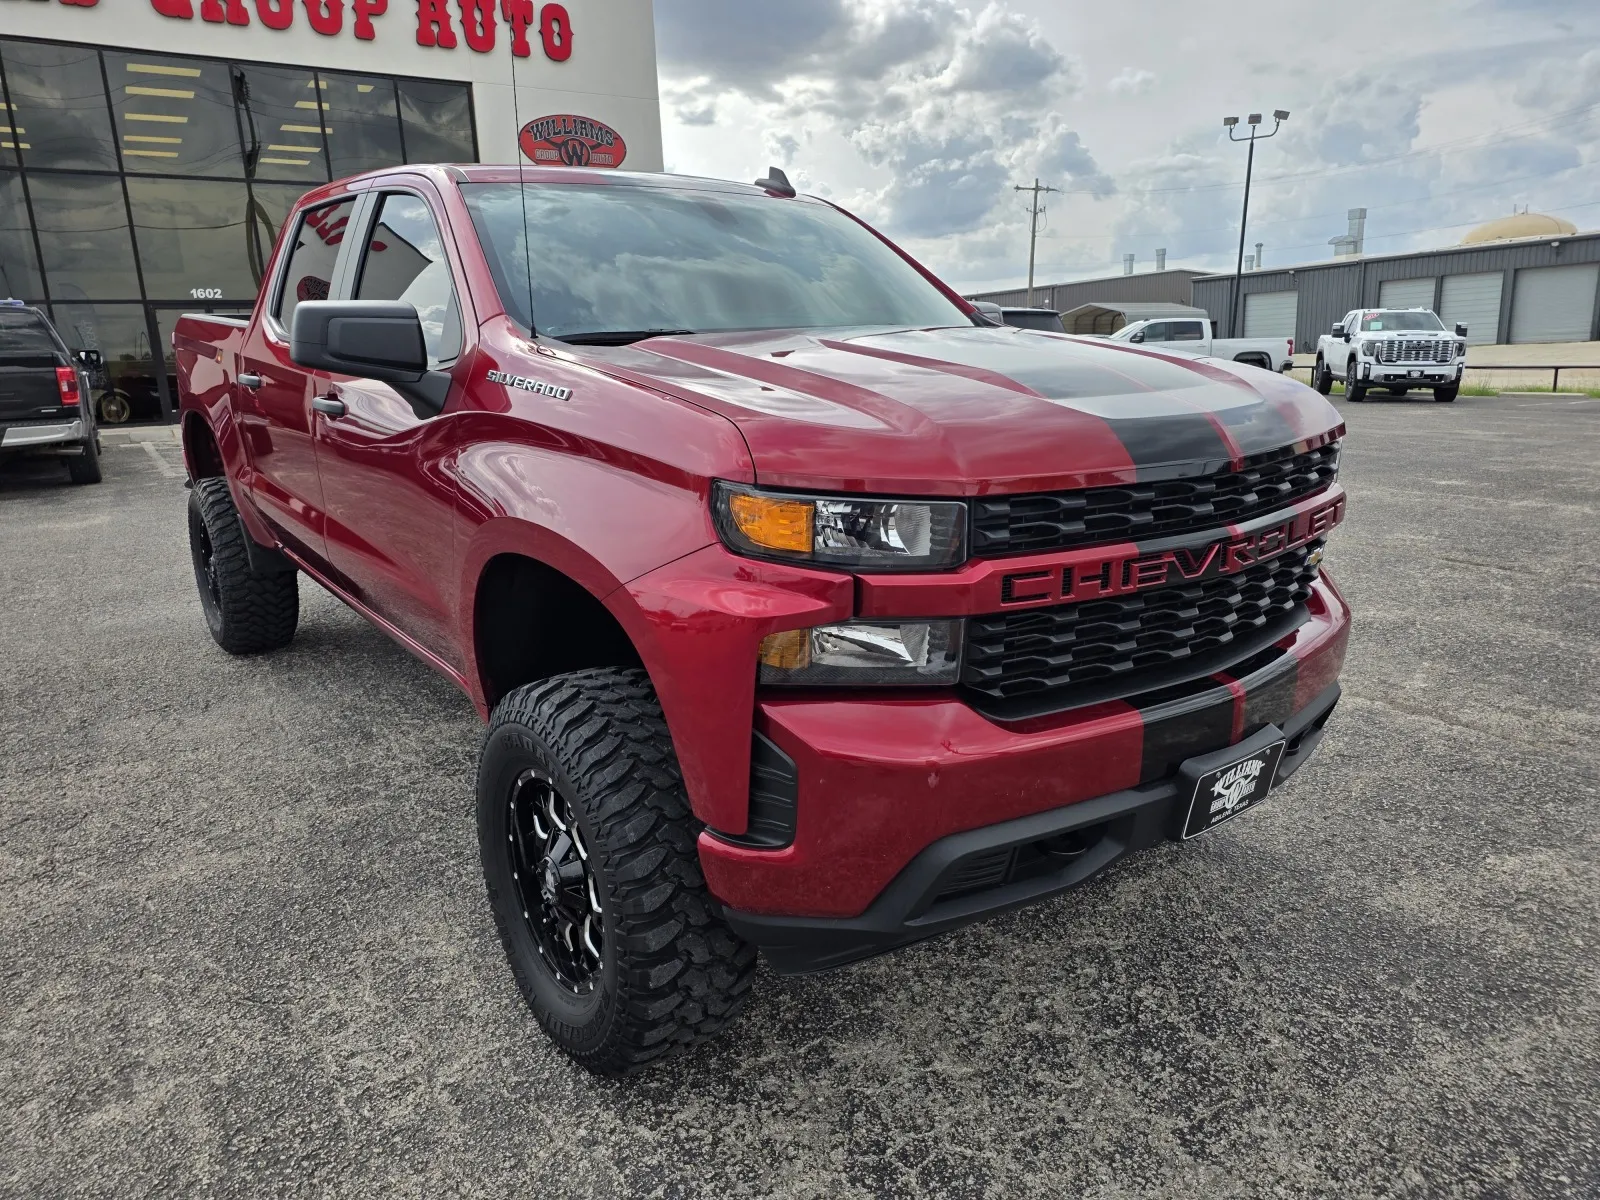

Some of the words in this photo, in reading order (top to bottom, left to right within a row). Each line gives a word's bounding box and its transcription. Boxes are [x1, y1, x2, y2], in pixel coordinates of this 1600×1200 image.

[416, 0, 574, 62] AUTO
[530, 118, 615, 148] WILLIAMS
[535, 148, 560, 160] GROUP
[591, 153, 613, 165] AUTO
[190, 288, 223, 299] 1602
[486, 370, 573, 401] SILVERADO
[1001, 502, 1344, 606] CHEVROLET
